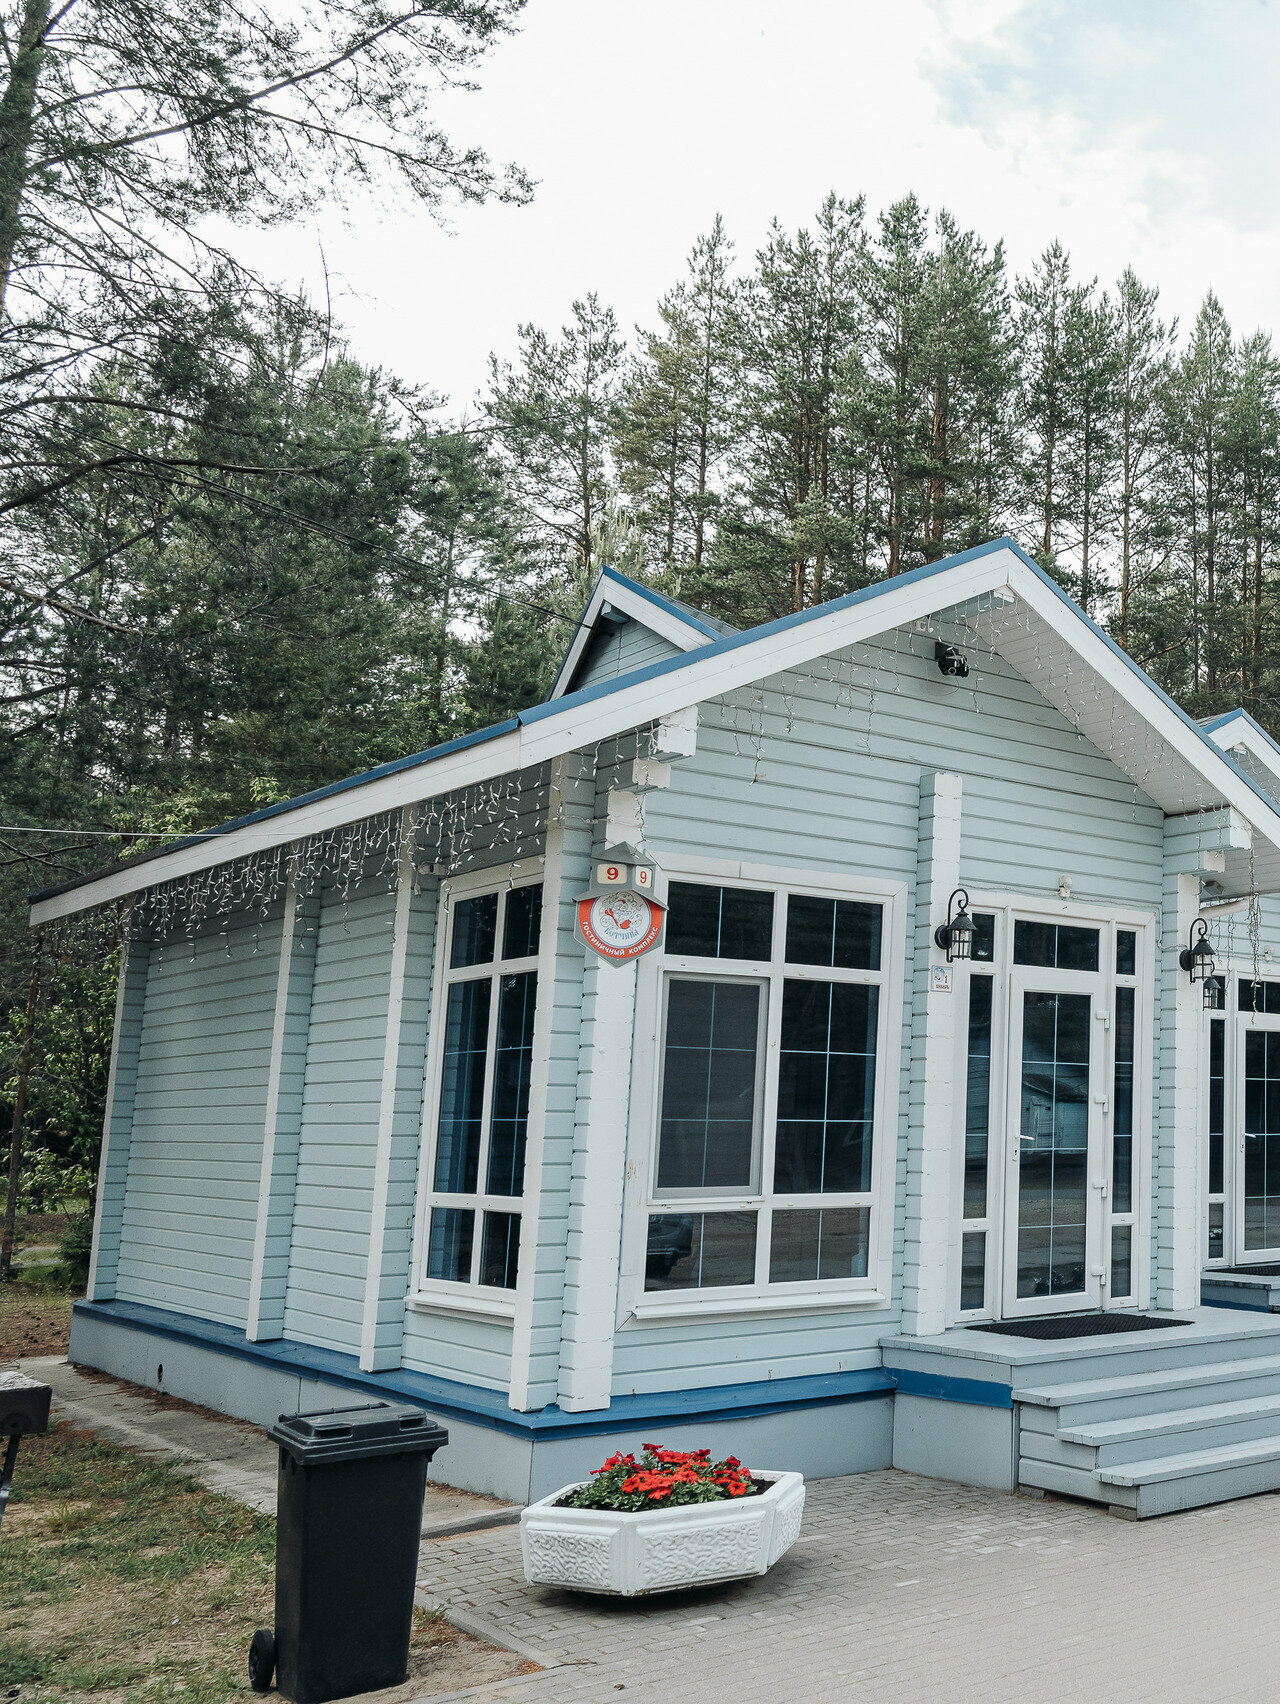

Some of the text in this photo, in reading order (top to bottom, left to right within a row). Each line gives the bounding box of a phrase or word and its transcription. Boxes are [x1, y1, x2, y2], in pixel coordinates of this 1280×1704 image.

[606, 867, 619, 880] 9
[640, 871, 647, 884] 9
[582, 921, 659, 956] ГОСТИНИЧНЫЙ КОМПЛЕКС
